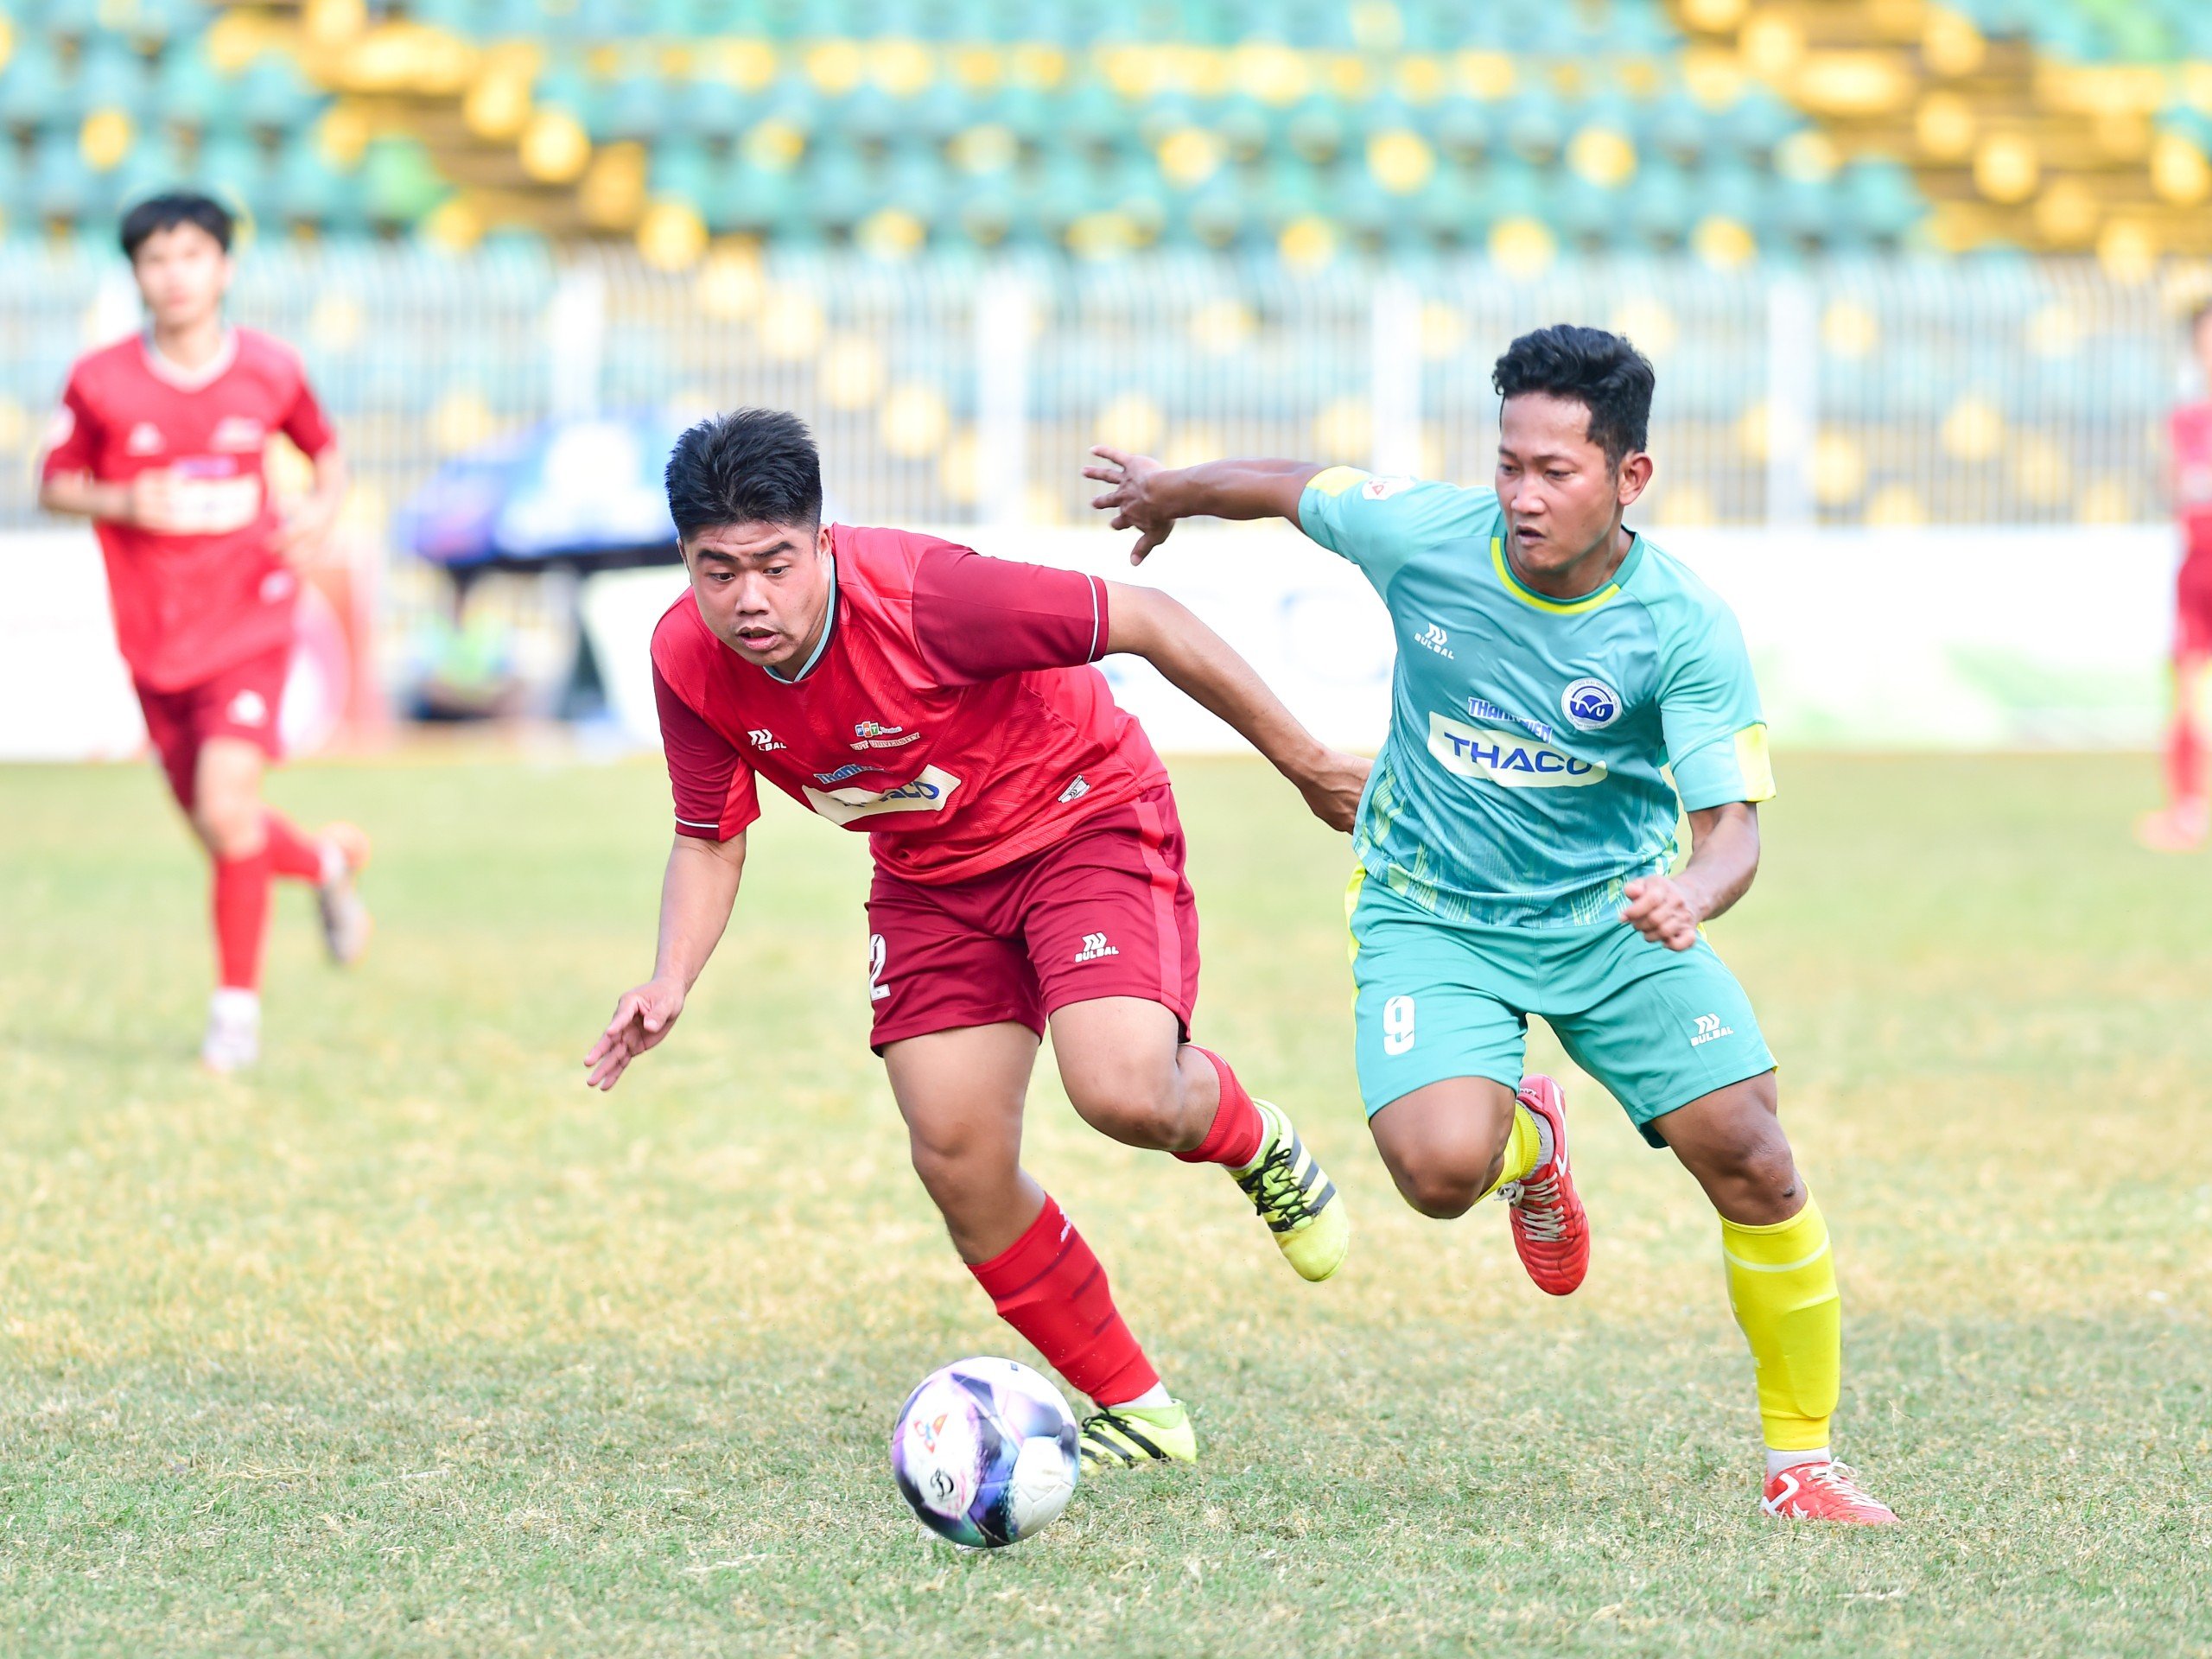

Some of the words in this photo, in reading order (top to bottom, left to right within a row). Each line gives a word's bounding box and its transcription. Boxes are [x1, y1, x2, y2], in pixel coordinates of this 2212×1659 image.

[855, 721, 879, 738] FPT
[869, 733, 920, 748] UNIVERSITY
[1444, 733, 1593, 775] THACO
[1383, 995, 1414, 1055] 9
